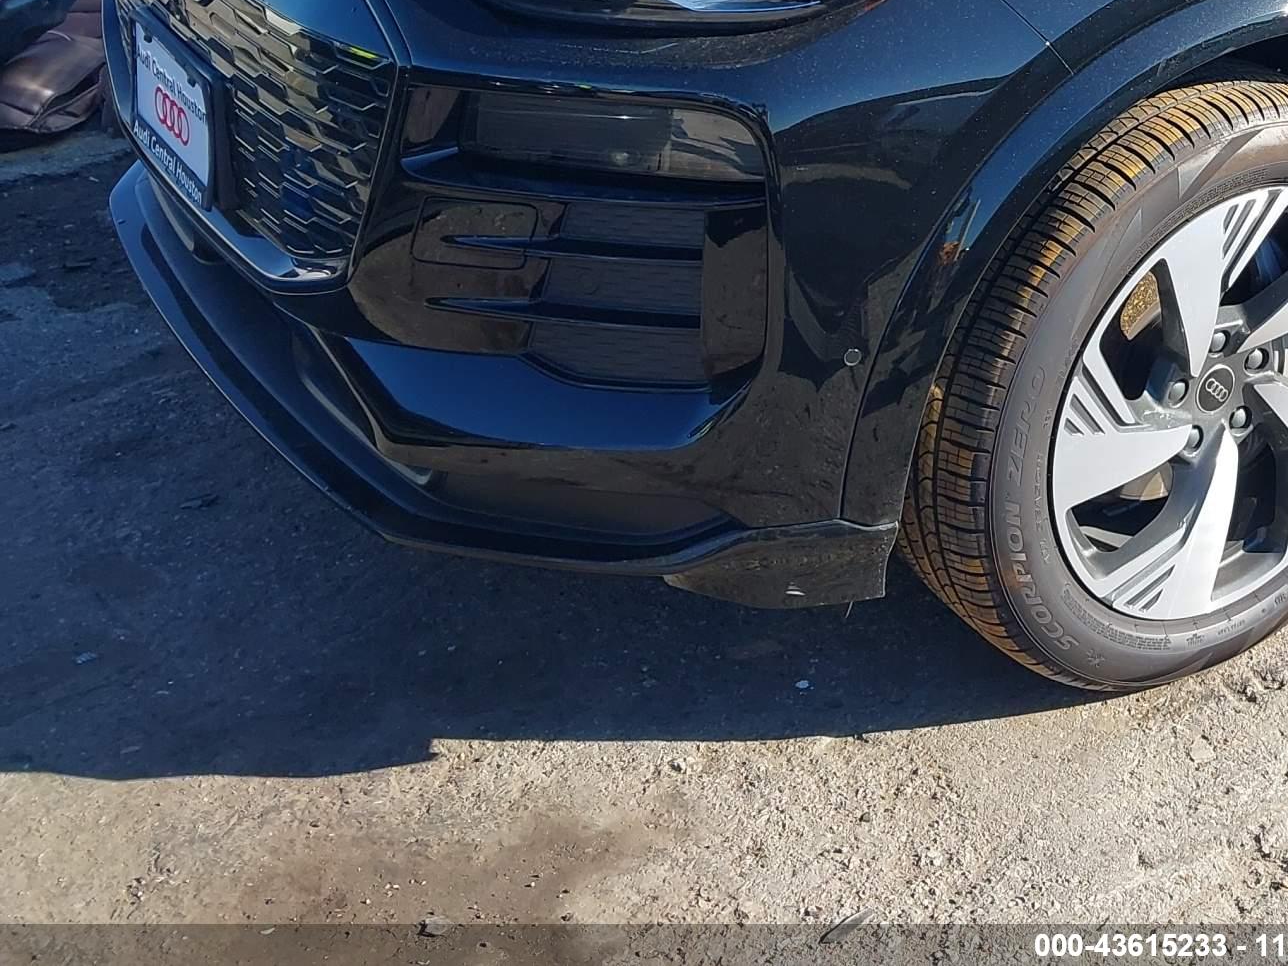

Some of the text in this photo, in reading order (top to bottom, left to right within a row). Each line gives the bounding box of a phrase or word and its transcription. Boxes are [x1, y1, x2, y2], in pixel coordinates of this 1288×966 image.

[137, 43, 206, 123] Audi Central Houston
[133, 119, 203, 206] Audi Central Houston
[1004, 366, 1080, 651] SCORPION ZERO
